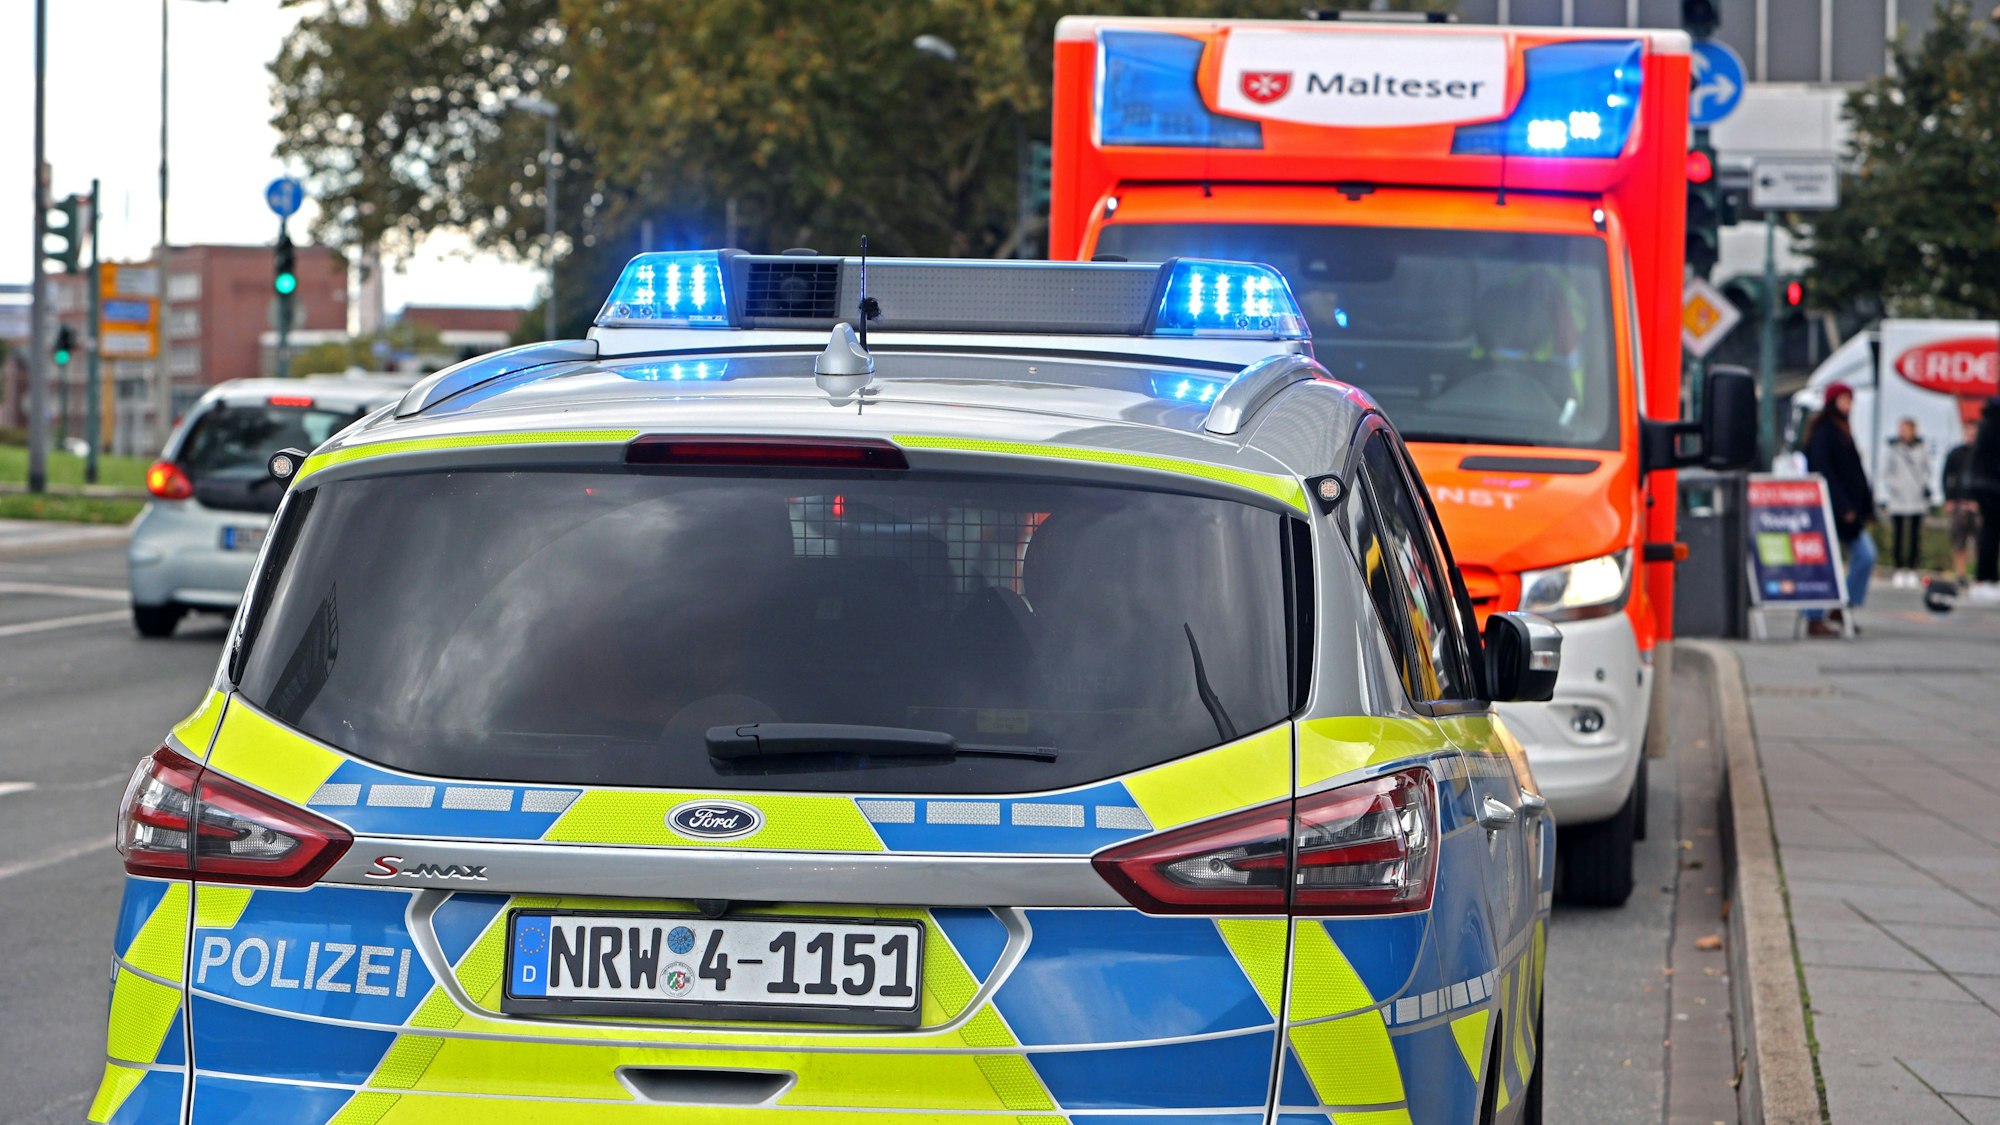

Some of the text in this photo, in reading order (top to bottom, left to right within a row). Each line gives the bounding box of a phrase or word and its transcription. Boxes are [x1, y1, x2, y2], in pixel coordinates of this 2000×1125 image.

[1306, 71, 1486, 99] Malteser
[689, 808, 739, 829] Ford
[364, 855, 488, 881] S-MAX
[196, 936, 412, 998] POLIZEI
[523, 964, 537, 983] D
[549, 925, 913, 997] NRW 4-1151
